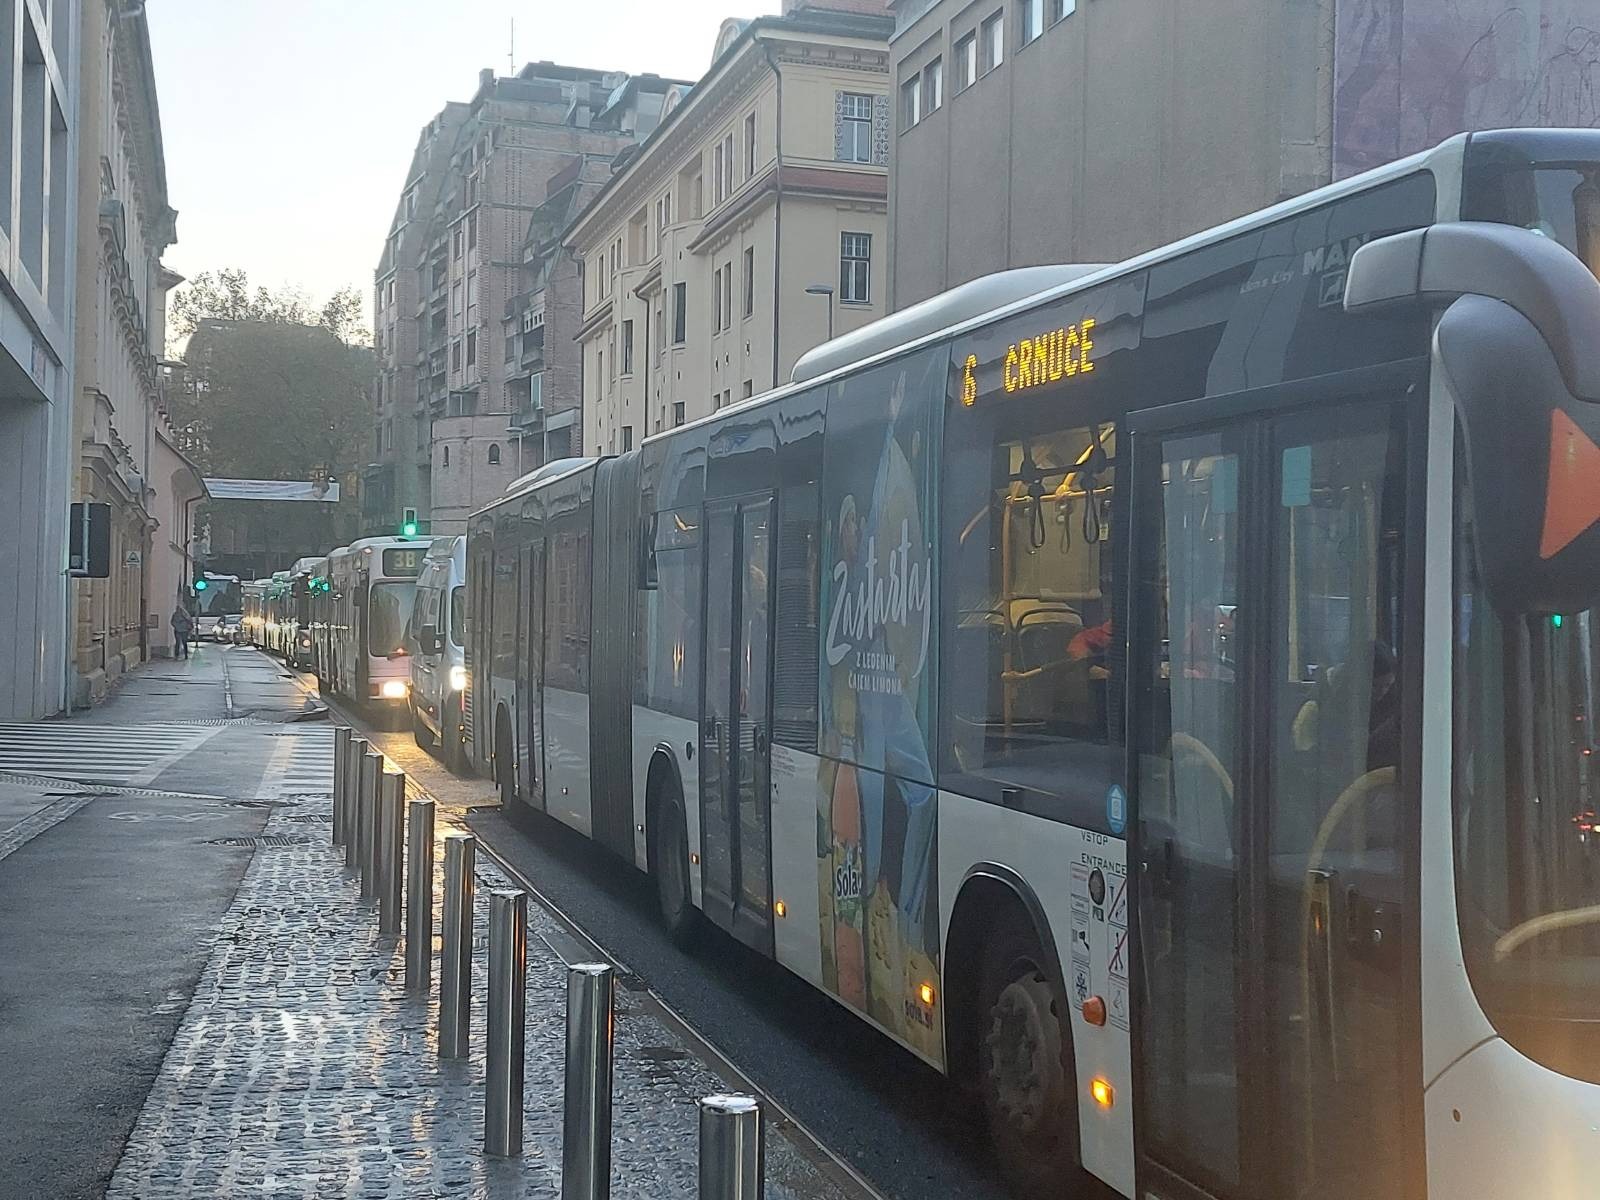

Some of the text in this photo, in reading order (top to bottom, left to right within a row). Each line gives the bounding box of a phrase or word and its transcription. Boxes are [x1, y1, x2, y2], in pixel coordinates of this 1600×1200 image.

[963, 354, 977, 406] 6
[1081, 830, 1109, 846] VSTOP
[1081, 852, 1127, 876] ENTRANCE
